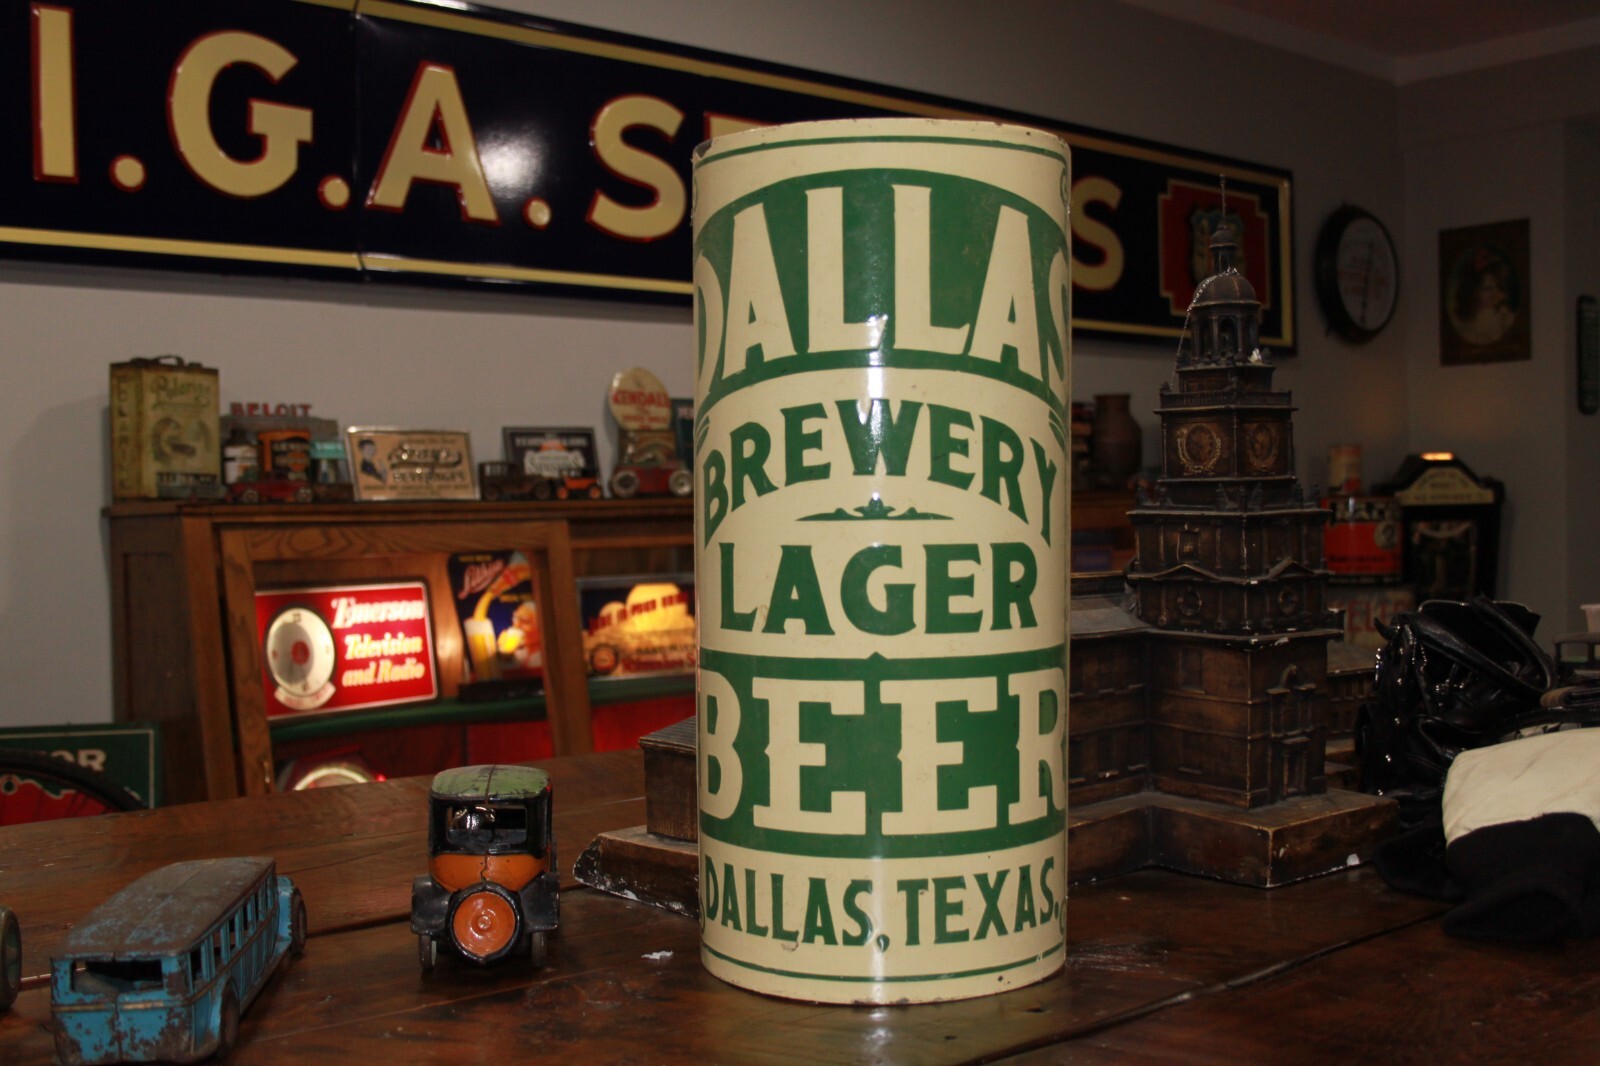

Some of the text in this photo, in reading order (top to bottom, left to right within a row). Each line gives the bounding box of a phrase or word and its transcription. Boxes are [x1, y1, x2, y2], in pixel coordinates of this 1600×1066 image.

[230, 402, 313, 418] BELOIT
[703, 399, 1057, 548] BREWERY
[331, 597, 426, 629] Emerson
[718, 541, 1038, 637] LAGER
[342, 657, 426, 687] and Radio
[343, 632, 424, 660] Television
[699, 667, 1067, 836] BEER
[704, 854, 1060, 953] DALLAS, TEXAS.
